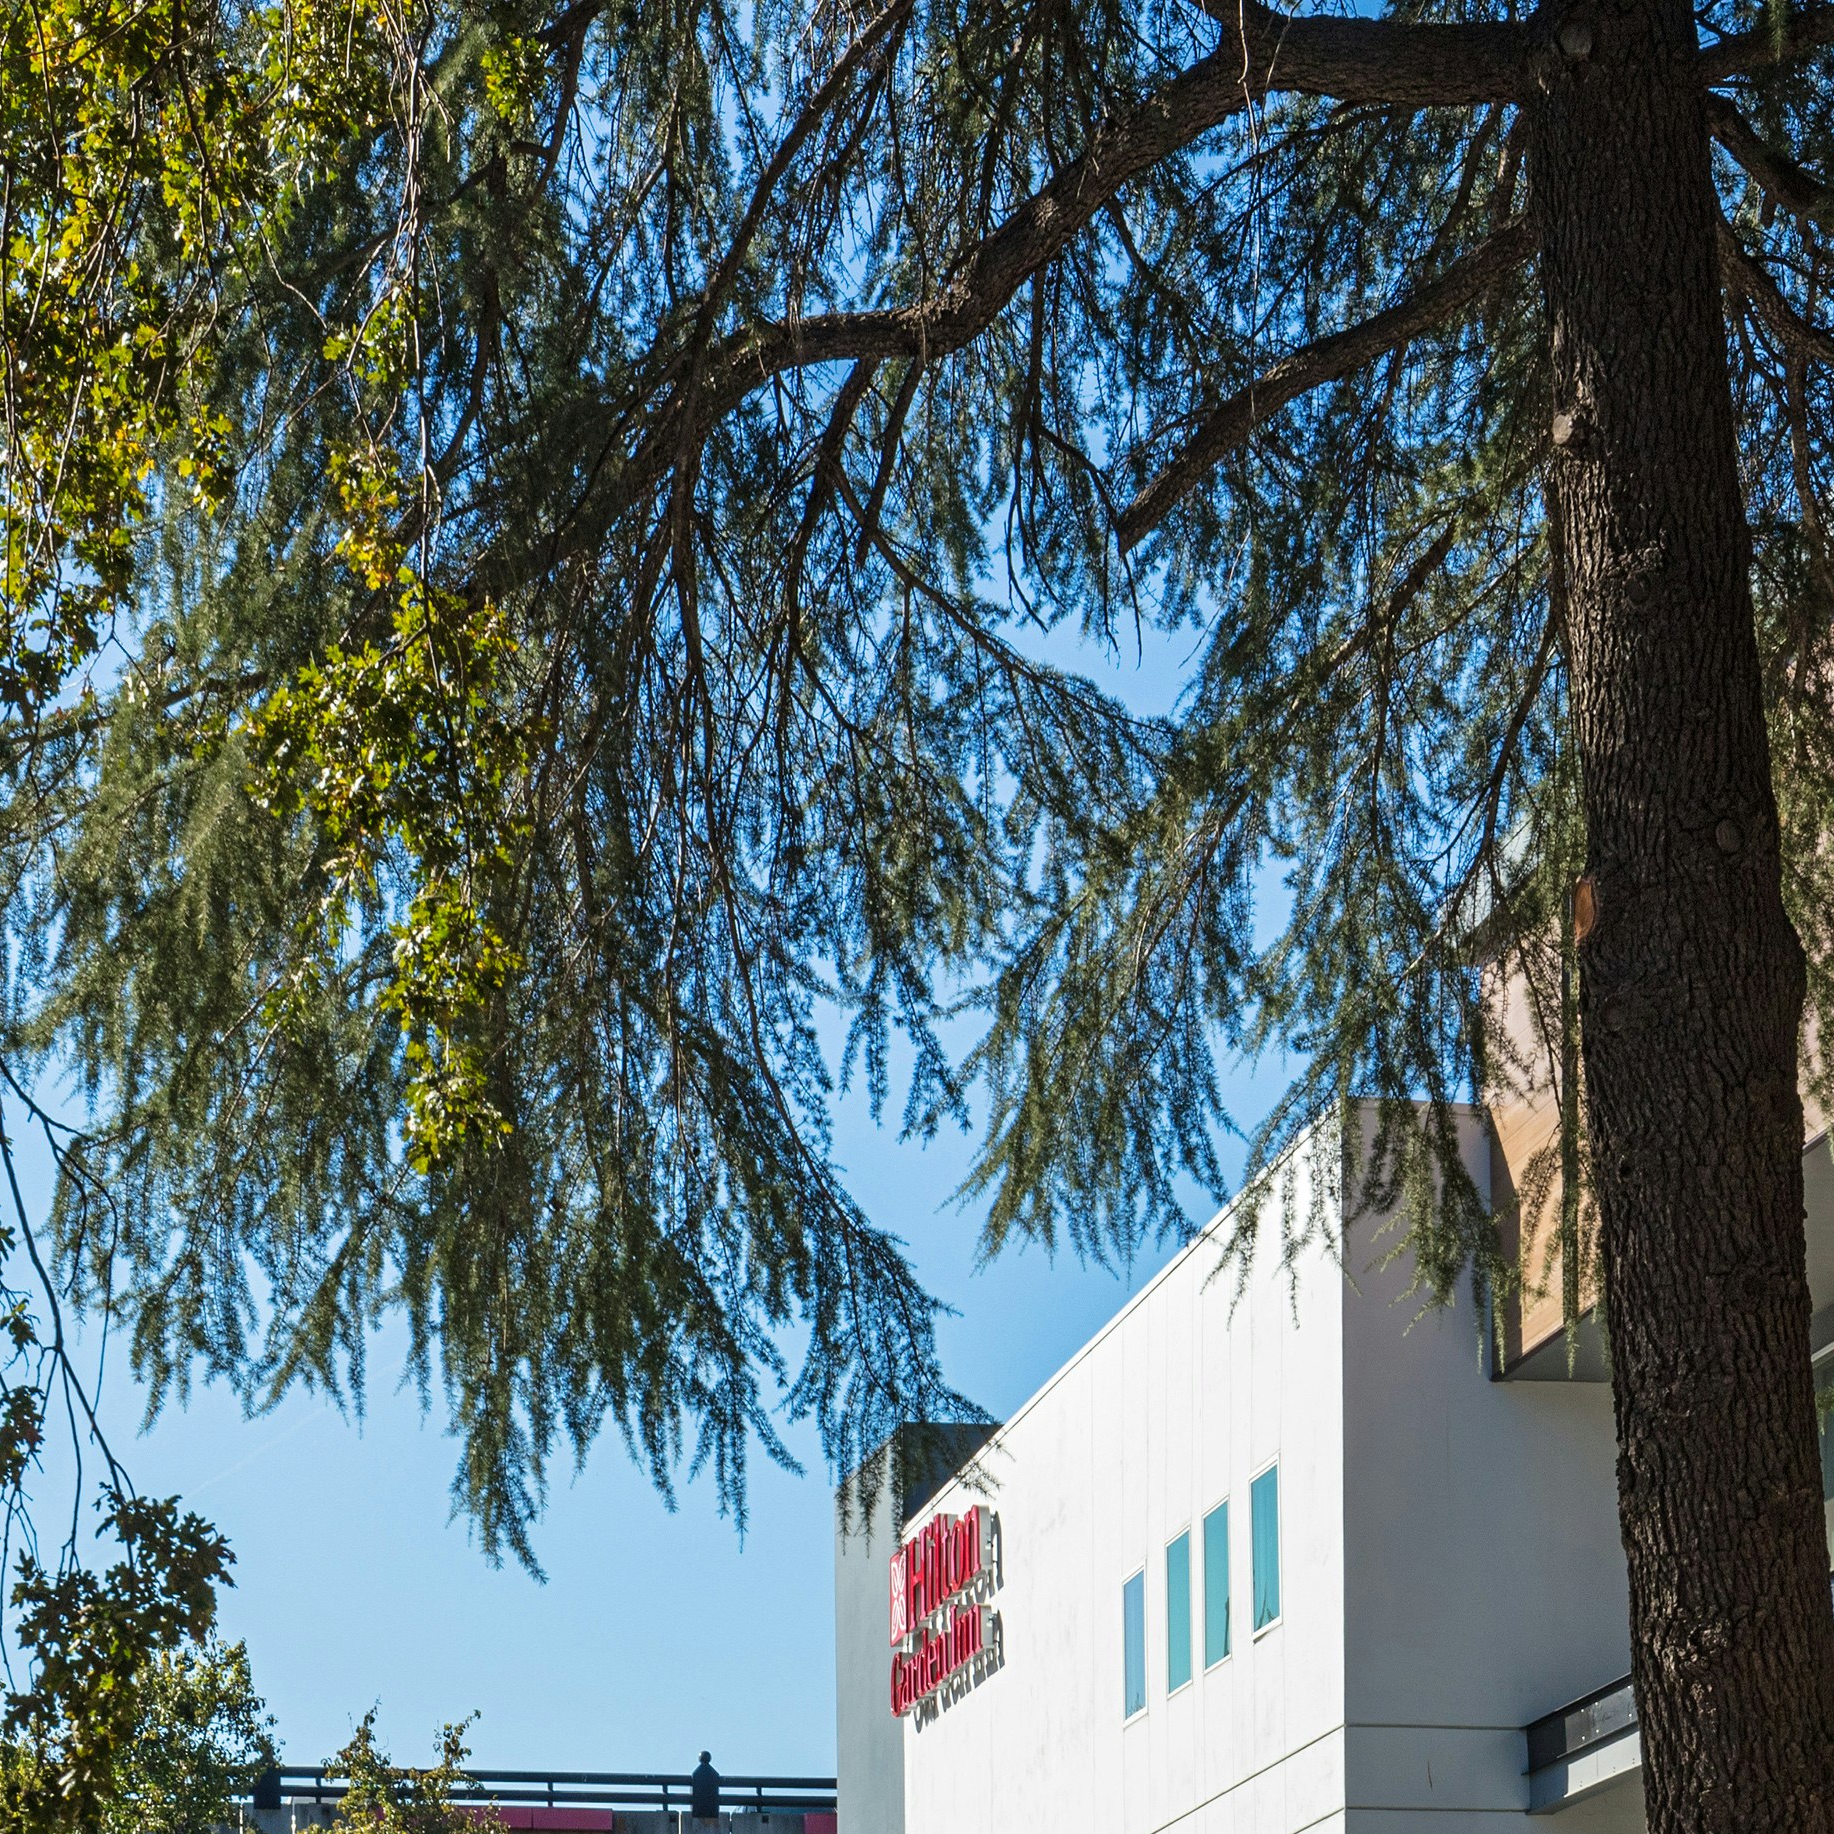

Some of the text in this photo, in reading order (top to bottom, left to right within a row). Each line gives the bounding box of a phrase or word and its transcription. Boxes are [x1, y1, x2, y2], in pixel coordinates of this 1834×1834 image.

[906, 1504, 983, 1633] Hilton
[890, 1603, 984, 1718] Garden Inn
